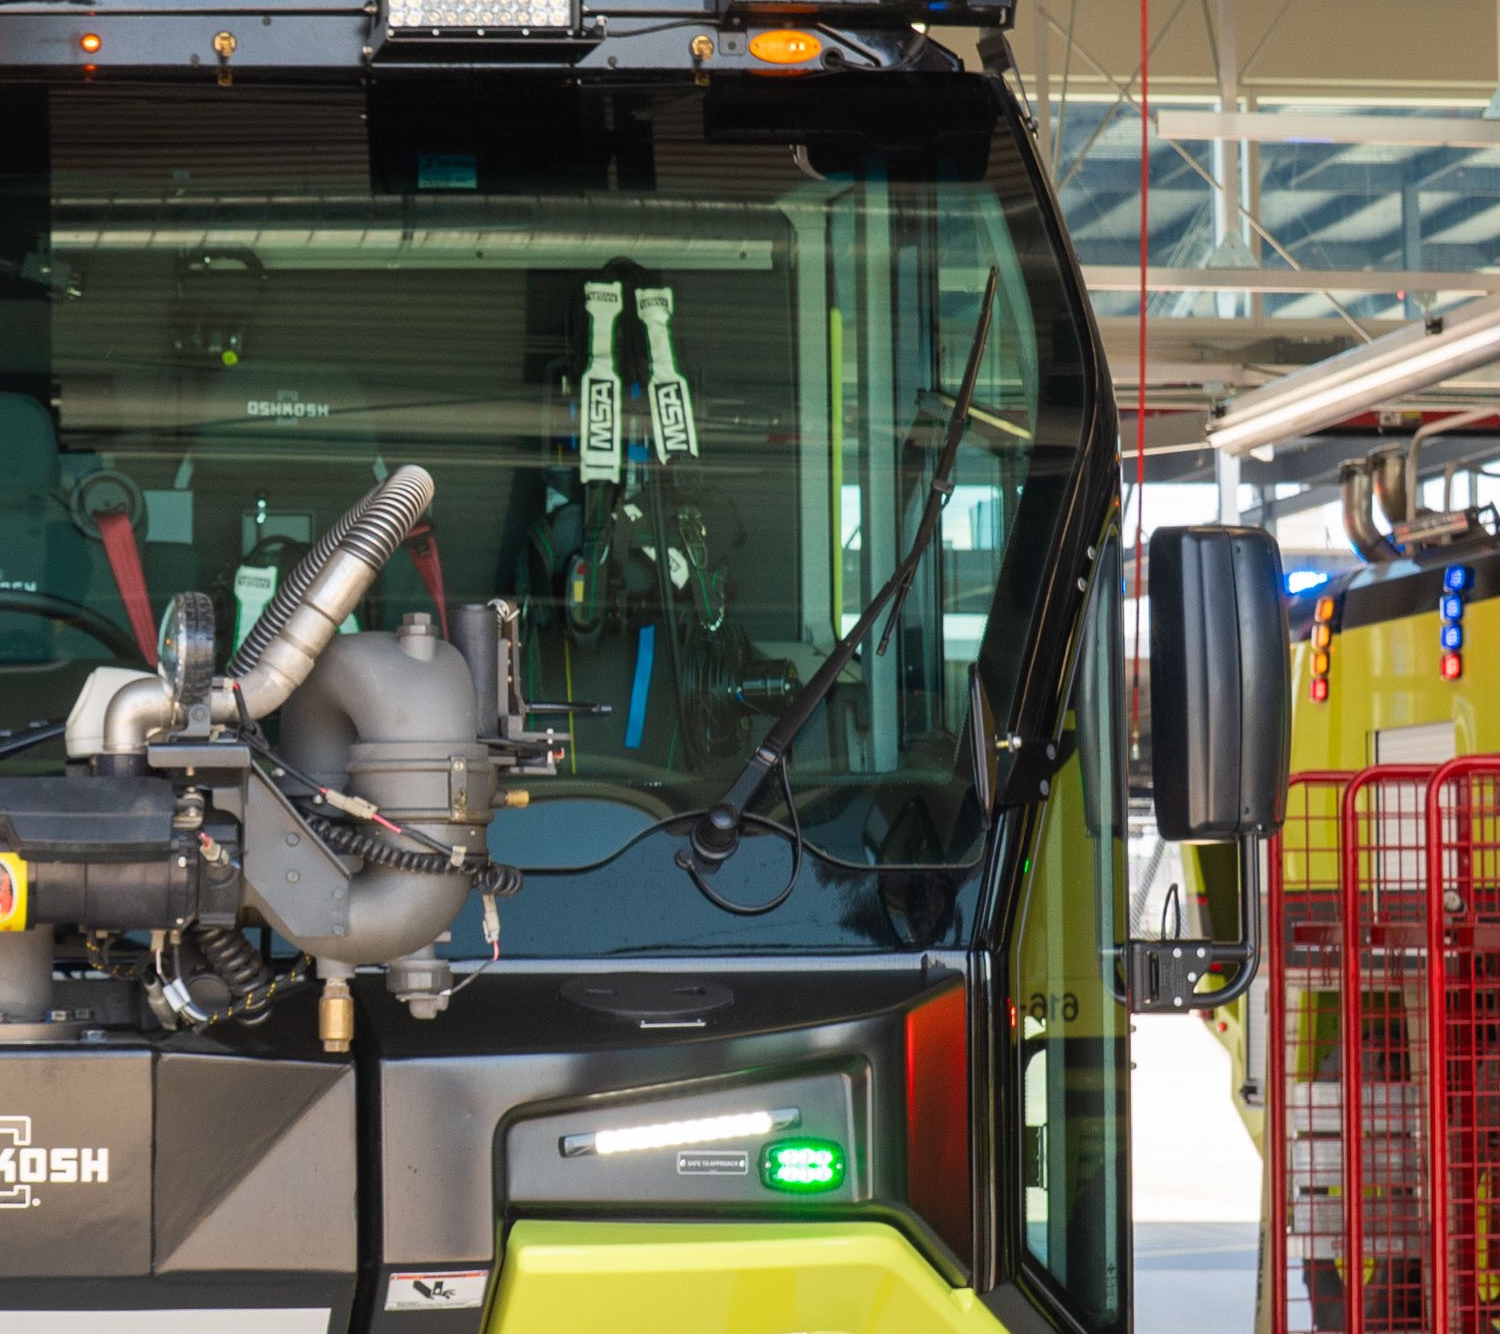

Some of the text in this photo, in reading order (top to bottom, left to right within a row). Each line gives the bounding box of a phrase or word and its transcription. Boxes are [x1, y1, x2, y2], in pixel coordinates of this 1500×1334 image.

[247, 400, 330, 417] OSHKOSH
[590, 380, 613, 451] MSA
[657, 382, 690, 452] MSA
